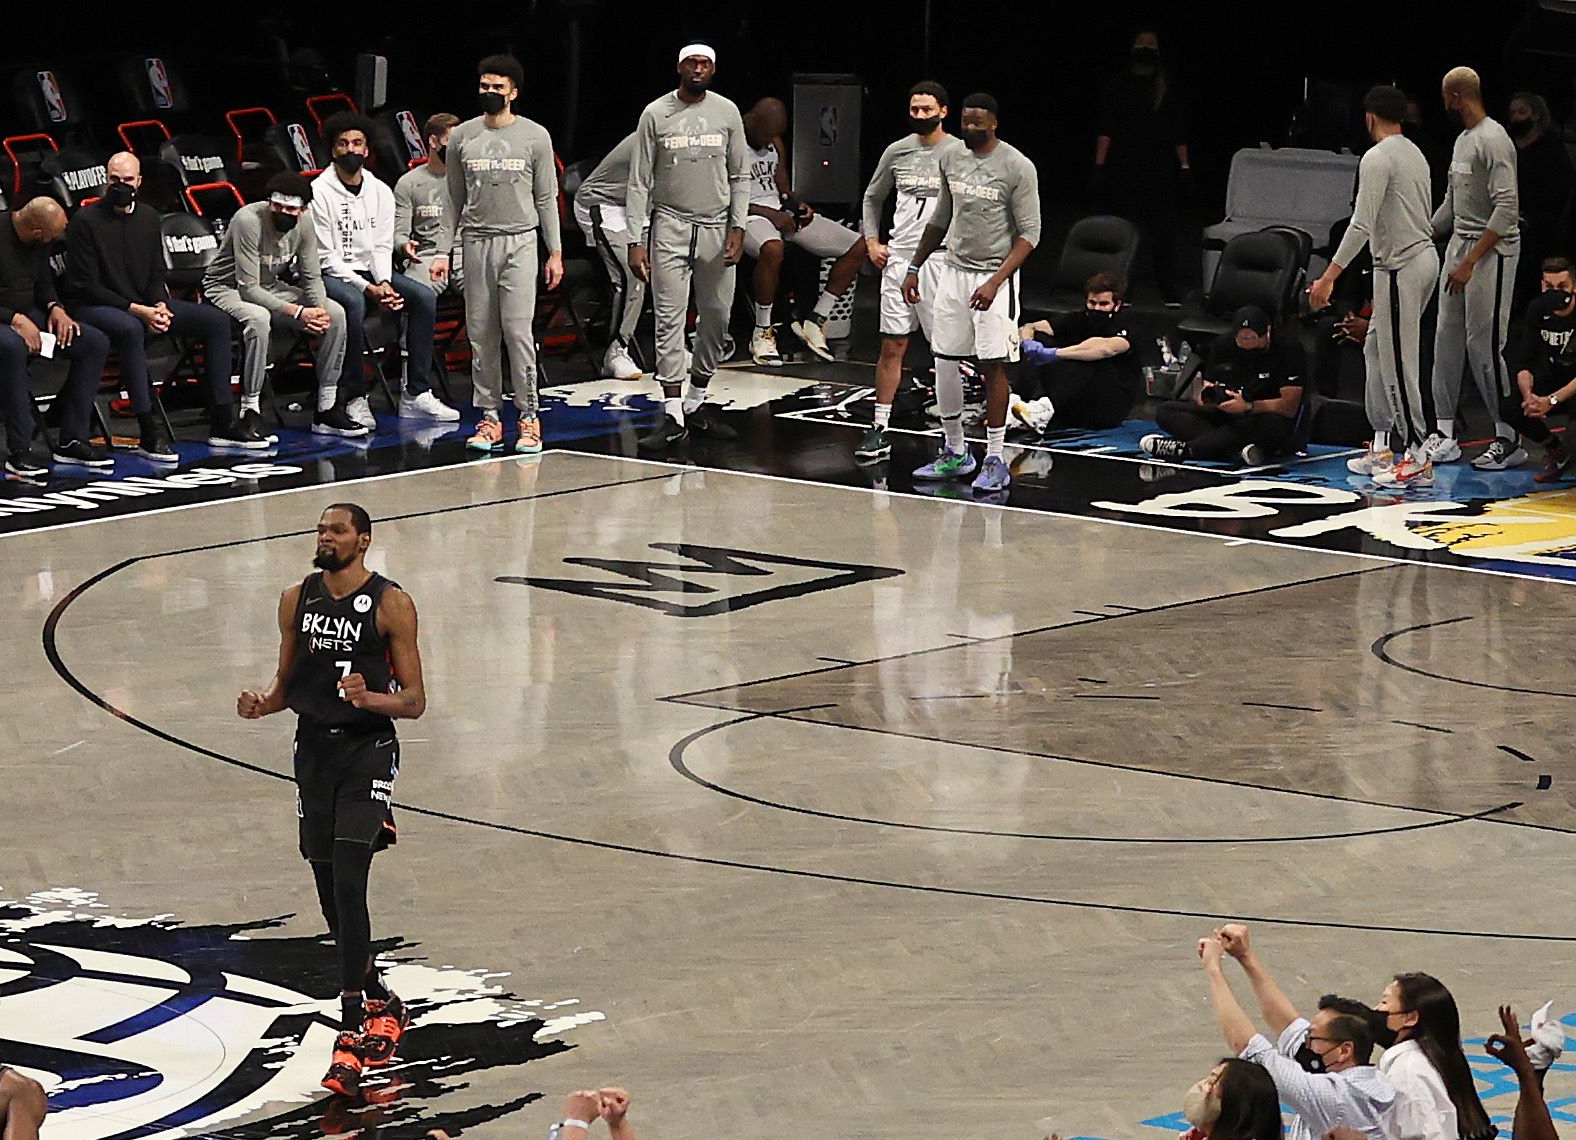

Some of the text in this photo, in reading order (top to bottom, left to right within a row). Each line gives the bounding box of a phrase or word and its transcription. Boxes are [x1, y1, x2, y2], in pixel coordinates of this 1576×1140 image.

[915, 195, 927, 220] 7
[301, 612, 363, 642] BKLYN
[311, 638, 353, 652] NETS
